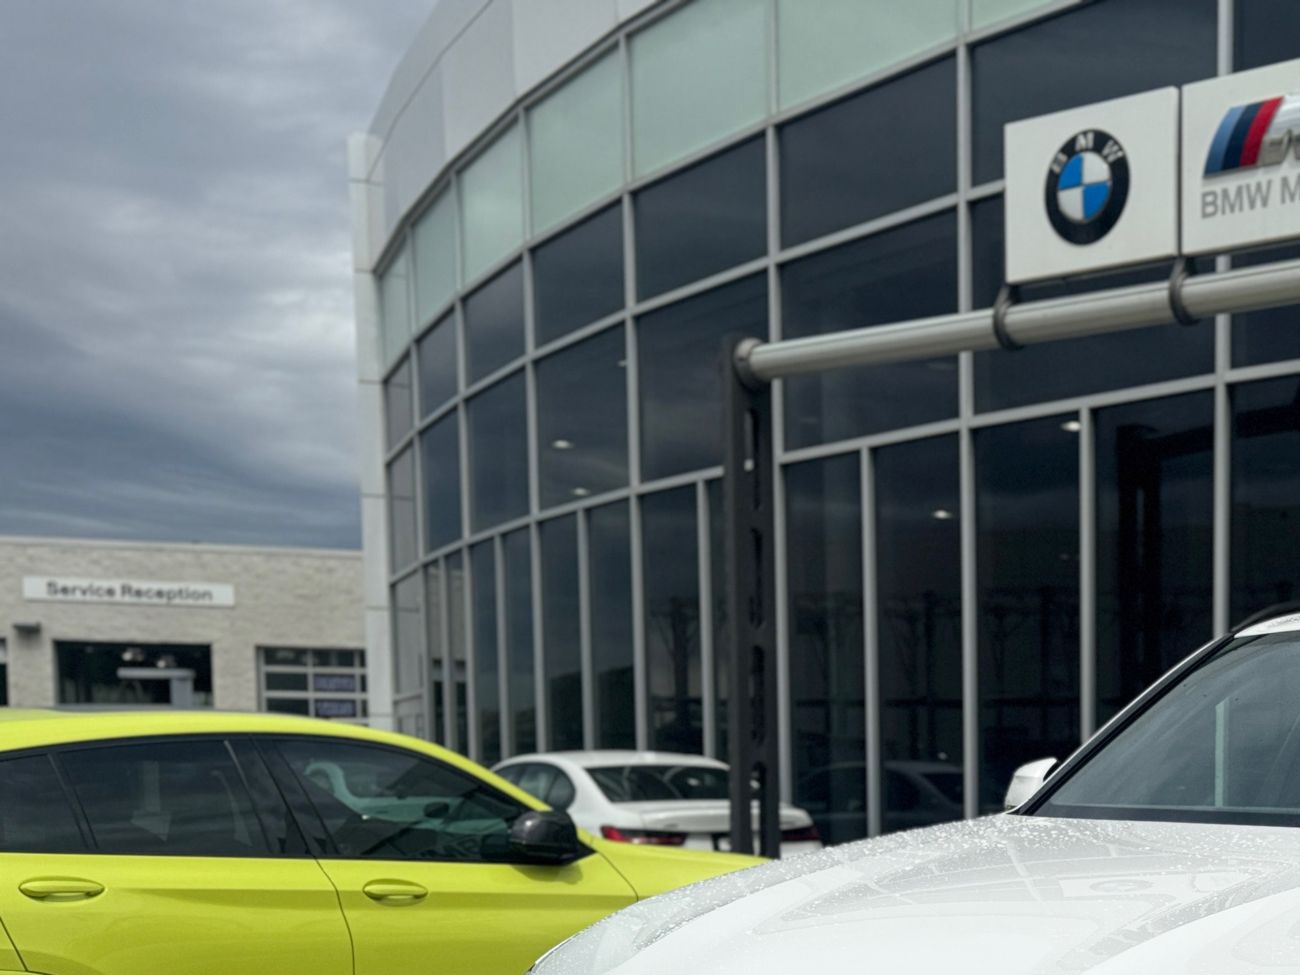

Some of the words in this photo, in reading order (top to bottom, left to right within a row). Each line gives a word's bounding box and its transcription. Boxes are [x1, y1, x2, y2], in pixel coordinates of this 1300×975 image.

[1201, 179, 1273, 220] BMW
[46, 580, 116, 598] Service
[120, 583, 213, 604] Reception
